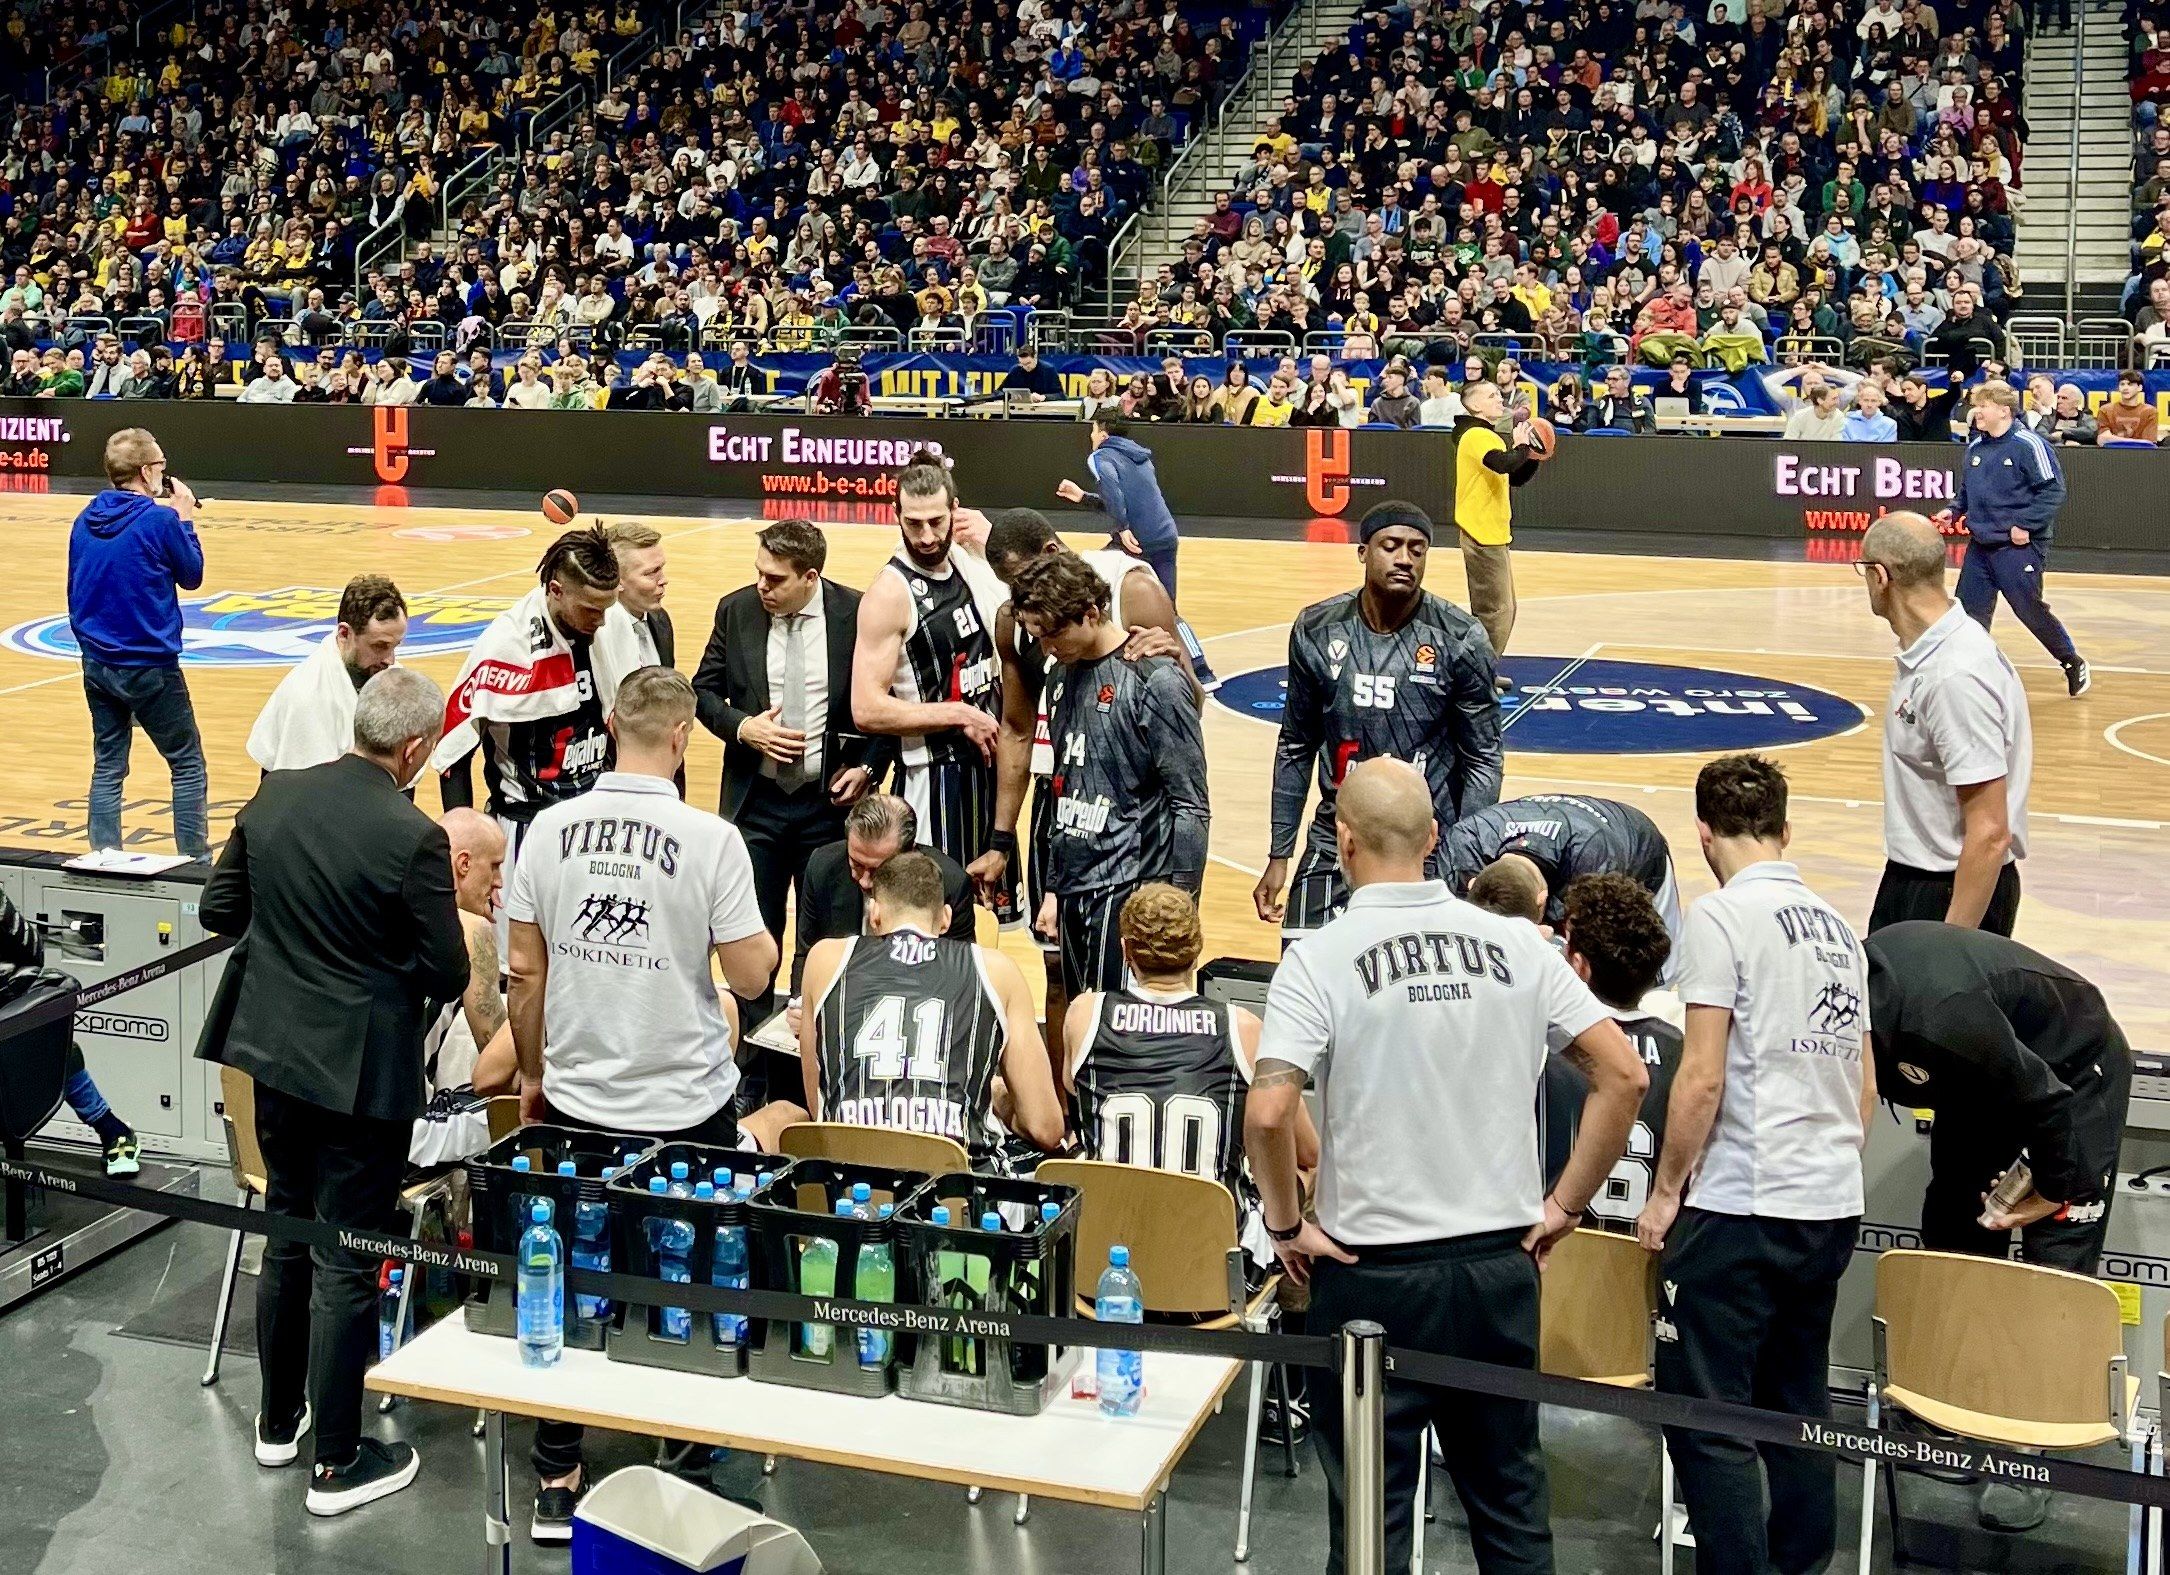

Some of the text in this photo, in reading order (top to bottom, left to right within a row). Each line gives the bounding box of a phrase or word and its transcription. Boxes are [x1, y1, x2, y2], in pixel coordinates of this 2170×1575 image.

[709, 426, 773, 462] ECHT
[762, 471, 898, 496] www.b-e-a.de
[1776, 454, 1956, 500] ECHT BERL
[952, 603, 980, 639] 21
[1353, 672, 1396, 710] 55
[1063, 732, 1086, 767] 14
[559, 817, 682, 879] VIRTUS
[588, 860, 642, 881] BOLOGNA
[551, 942, 670, 971] ISOKINETIC
[1353, 930, 1515, 999] VIRTUS
[77, 963, 166, 1006] Mercedes-Benz Arena
[1408, 983, 1472, 1003] BOLOGNA
[74, 1013, 165, 1038] xpromo
[1111, 1003, 1218, 1036] CORDINIER
[853, 995, 946, 1082] 41
[840, 1096, 964, 1137] BOLOGNA
[37, 1170, 77, 1192] Arena
[338, 1230, 499, 1275] Mercedes-Benz Arena
[813, 1301, 1011, 1337] Mercedes-Benz Arena
[1800, 1422, 2050, 1483] Mercedes-Benz Arena
